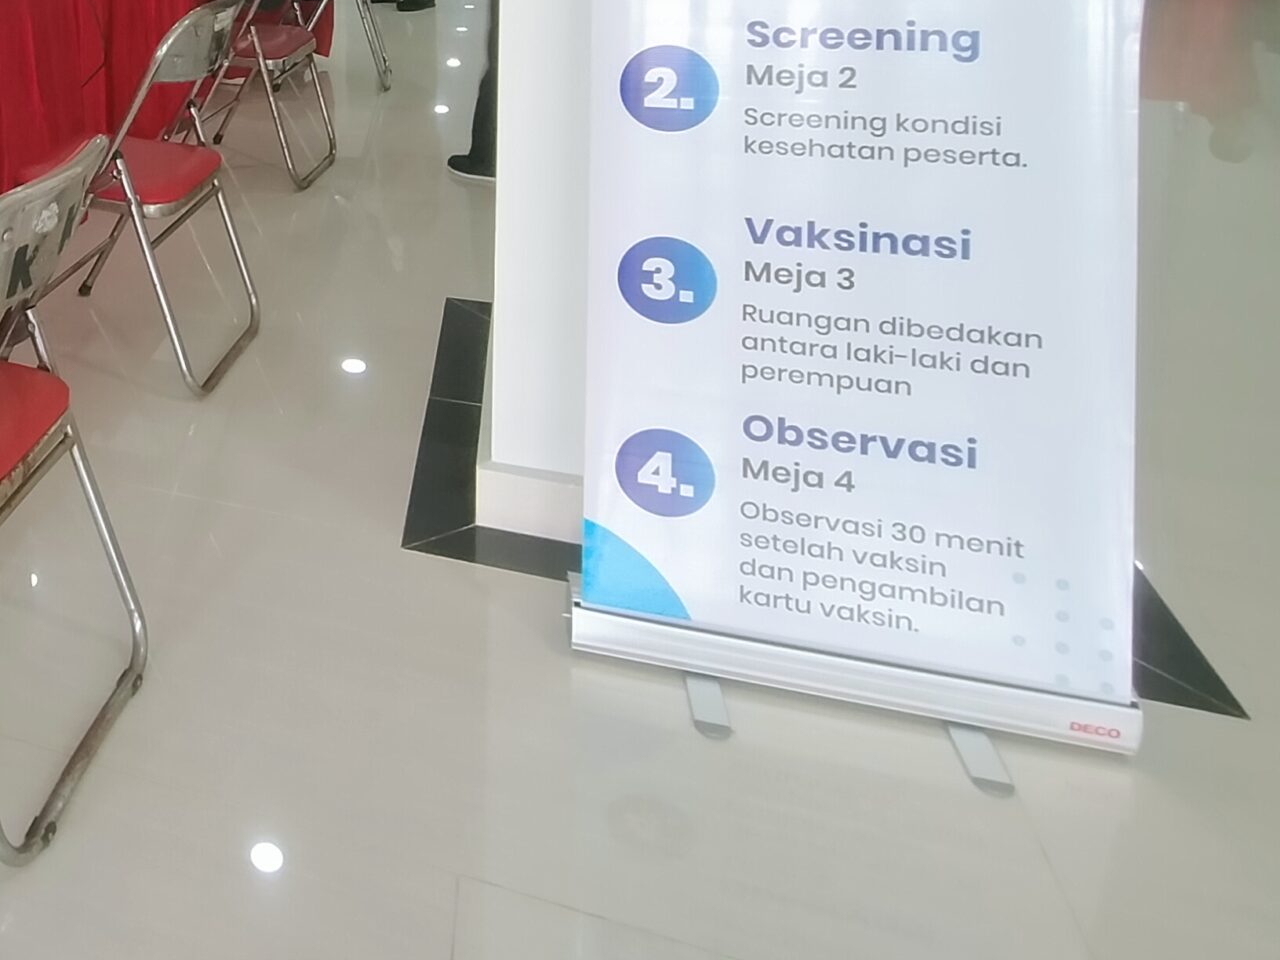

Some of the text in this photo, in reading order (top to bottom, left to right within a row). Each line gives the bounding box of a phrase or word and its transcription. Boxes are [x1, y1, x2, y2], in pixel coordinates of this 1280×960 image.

[746, 19, 982, 64] Screening
[643, 66, 695, 111] 2.
[745, 63, 858, 95] Meja 2
[743, 107, 1002, 138] Screening kondisi
[743, 135, 1028, 169] kesehatan peserta.
[744, 217, 972, 261] Vaksinasi
[640, 256, 695, 304] 3.
[743, 260, 856, 294] Meja 3
[742, 303, 1044, 350] Ruangan dibedakan
[741, 334, 1031, 380] antara laki-laki dan
[741, 360, 912, 397] perempuan
[742, 415, 978, 470] Observasi
[637, 451, 695, 499] 4.
[741, 457, 856, 493] Meja 4
[740, 500, 1025, 560] Observasi 30 menit
[739, 528, 947, 578] setelah vaksin
[738, 585, 920, 635] kartu vaksin.
[739, 558, 1006, 618] dan pengambilan
[1069, 721, 1121, 739] DECO
